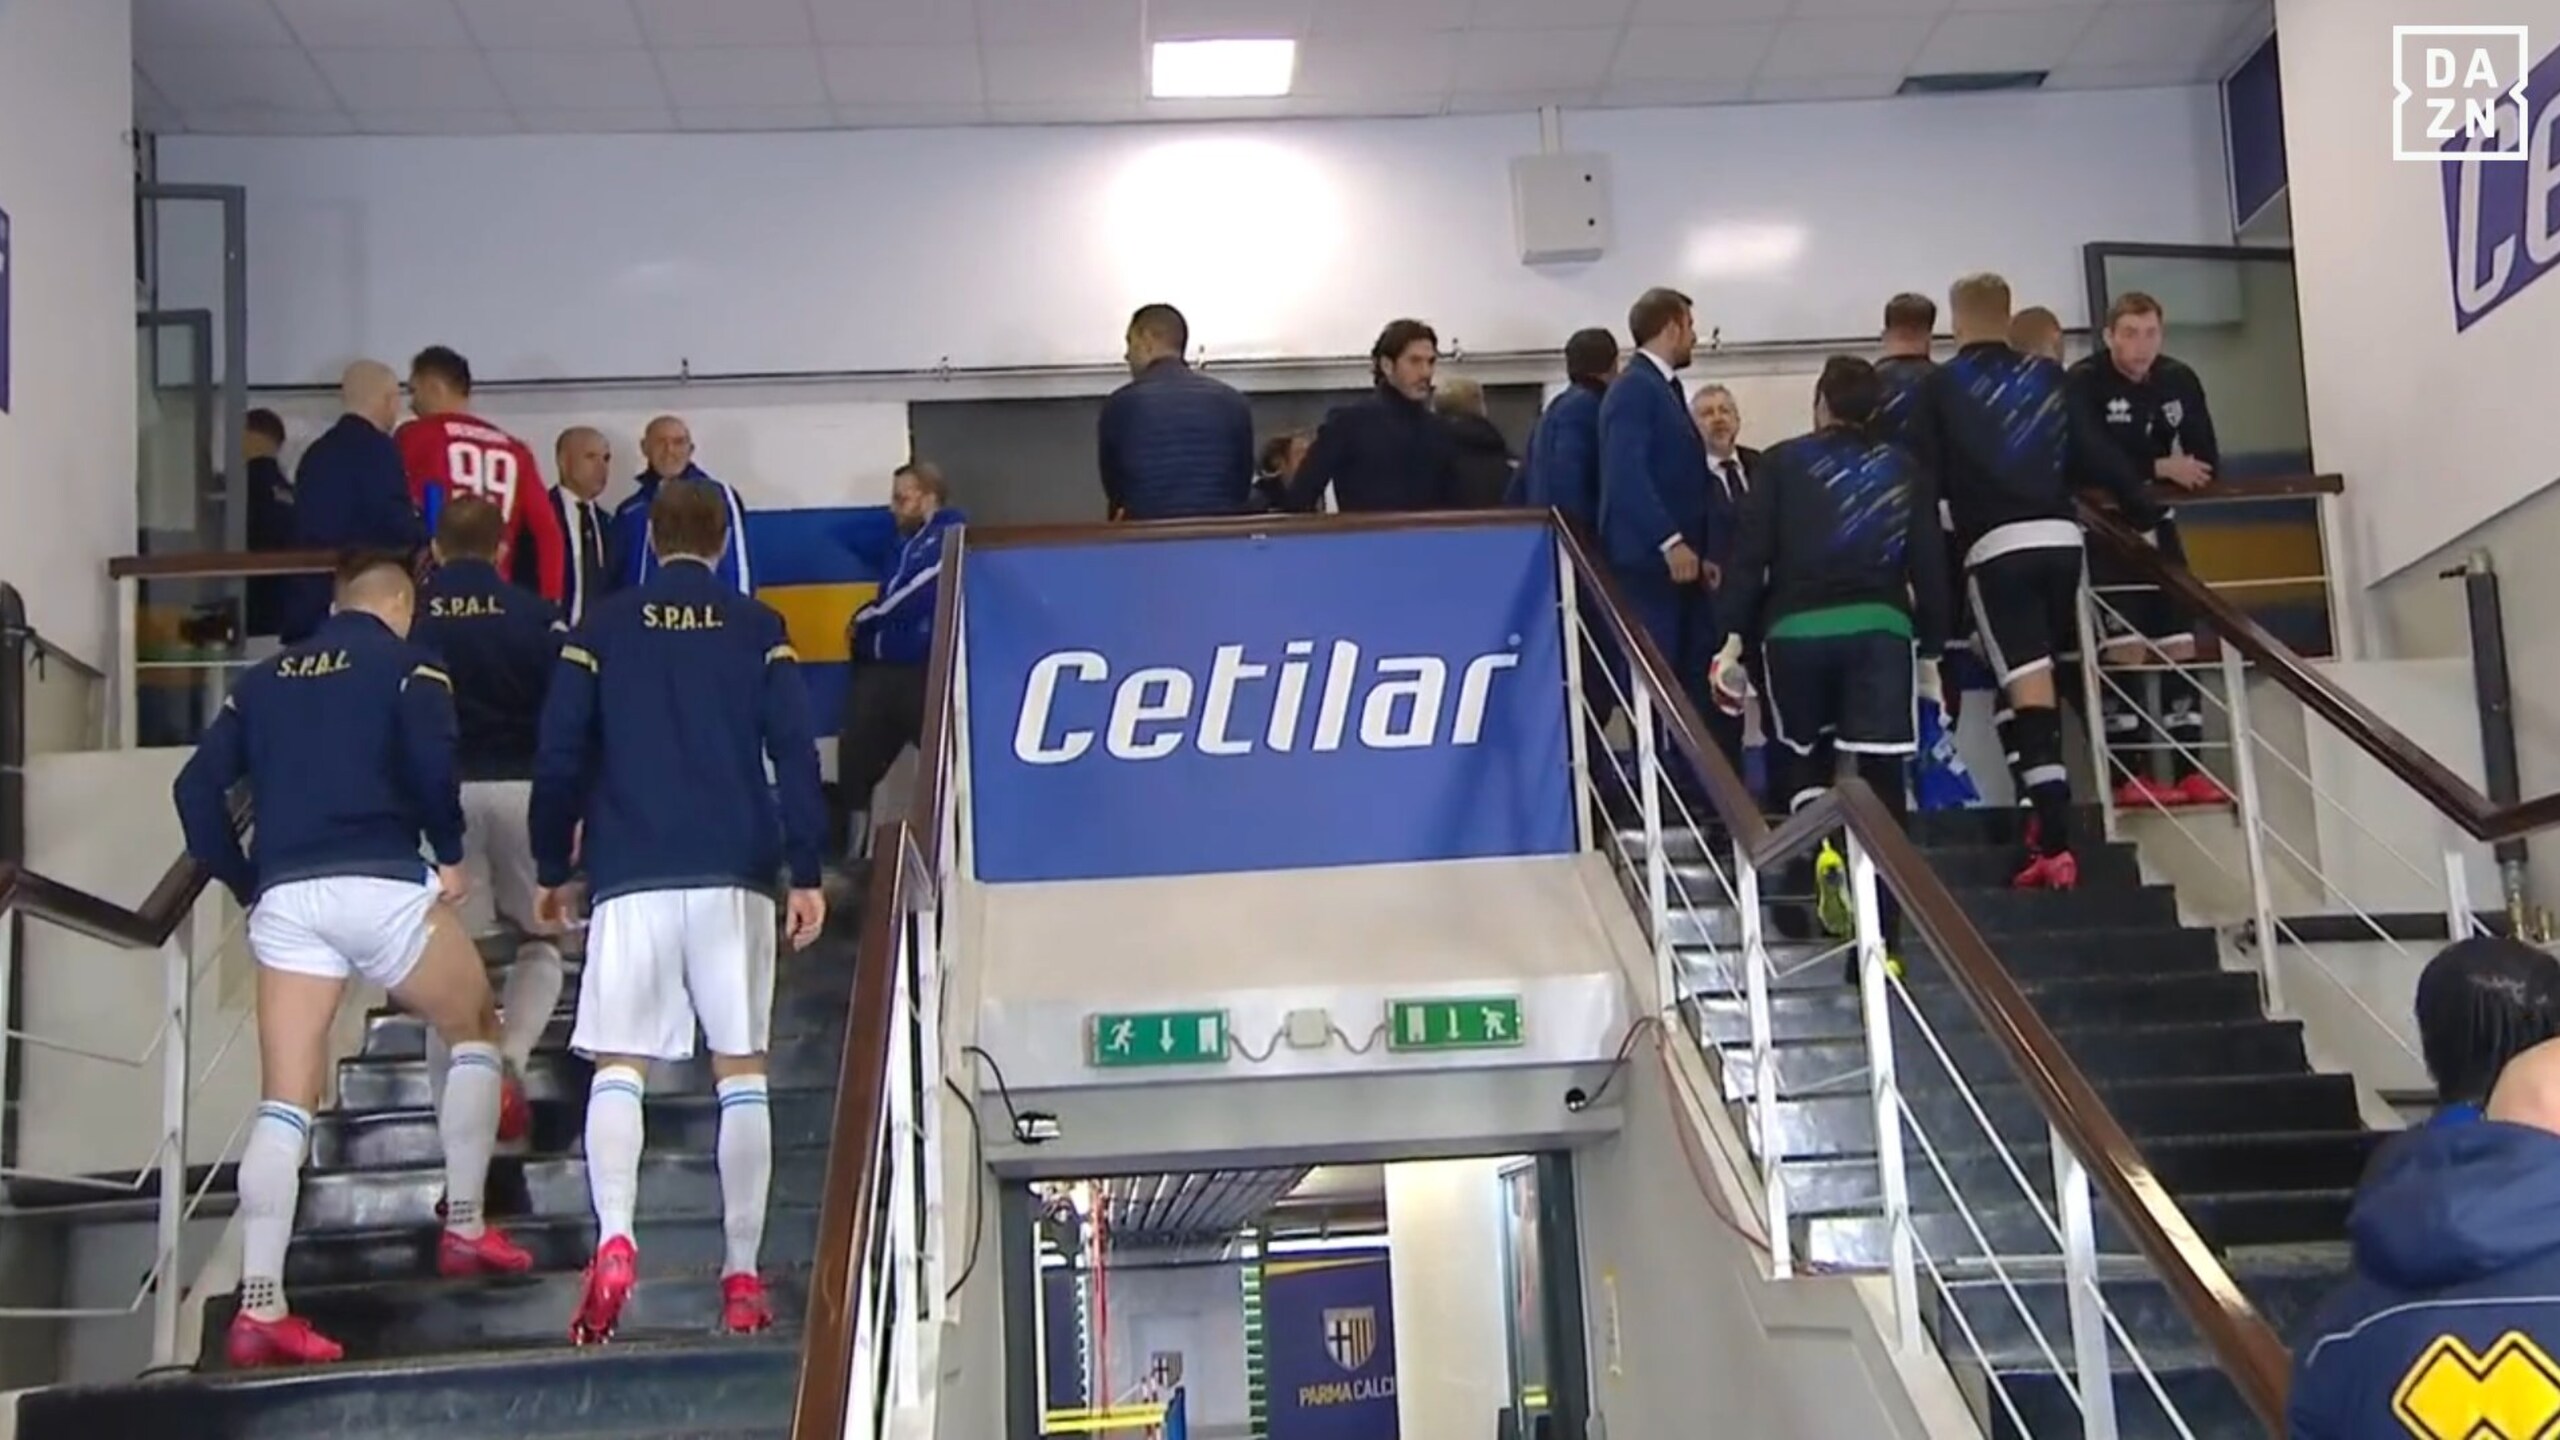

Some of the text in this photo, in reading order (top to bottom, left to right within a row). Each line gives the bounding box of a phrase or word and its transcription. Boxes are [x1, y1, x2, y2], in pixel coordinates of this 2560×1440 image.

[447, 441, 518, 524] 99
[429, 594, 507, 617] S.P.A.L.
[642, 603, 724, 630] S.P.A.L.
[1013, 639, 1519, 765] Cetilar
[1299, 1381, 1353, 1408] PARMA
